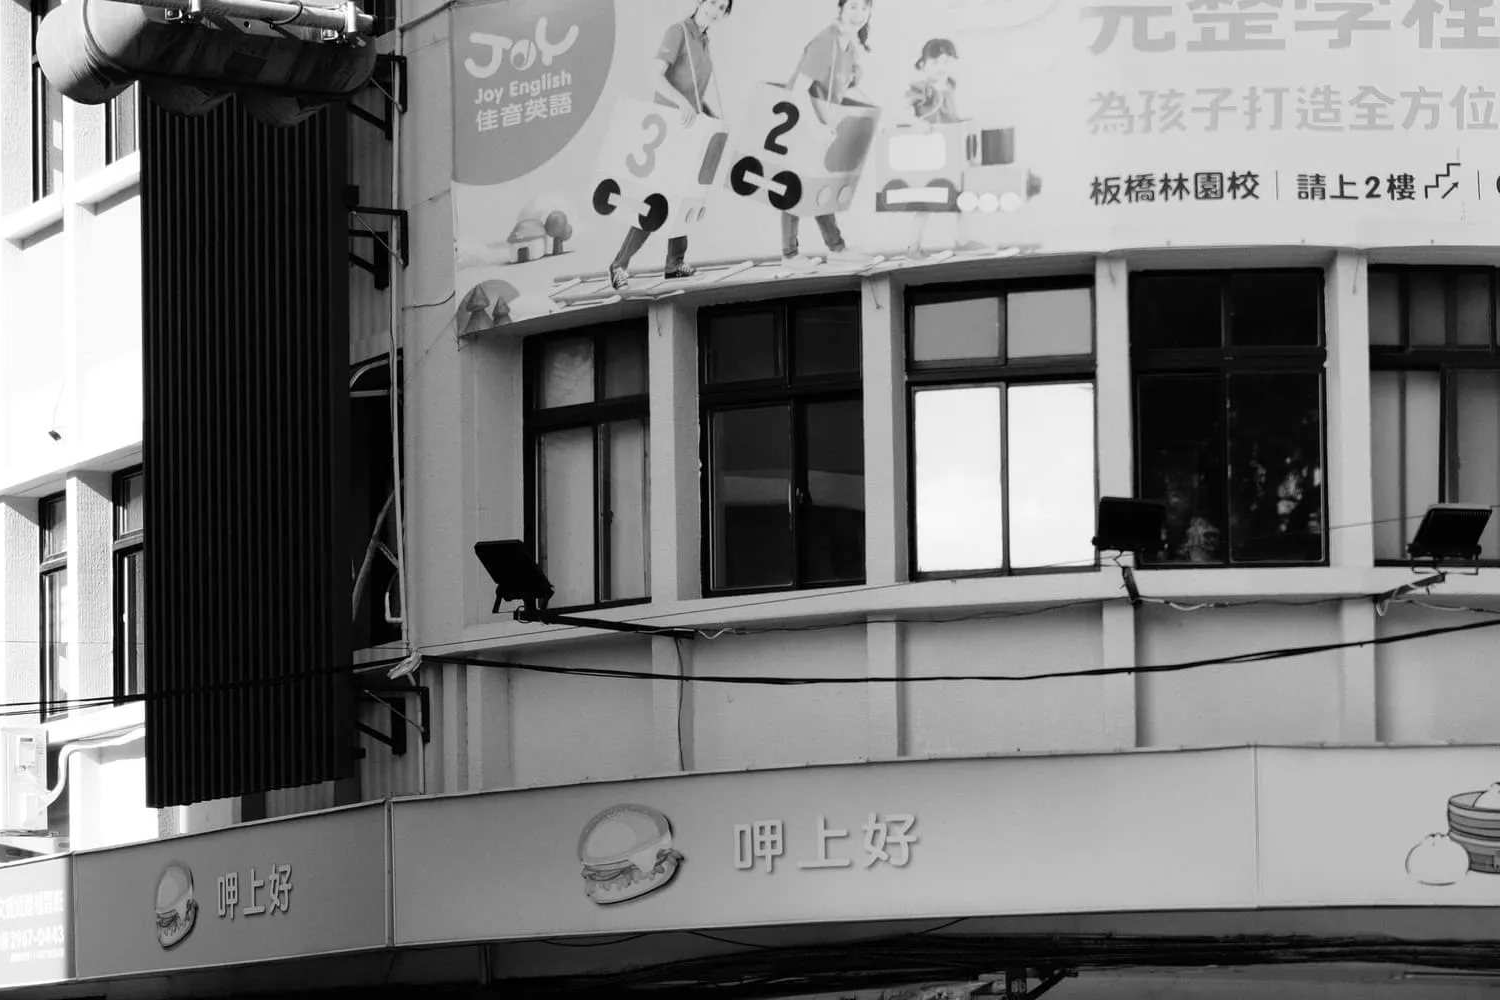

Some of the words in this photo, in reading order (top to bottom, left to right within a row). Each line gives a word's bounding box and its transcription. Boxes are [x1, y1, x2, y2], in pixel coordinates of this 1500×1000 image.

[474, 83, 504, 105] Joy
[509, 70, 572, 97] English
[476, 94, 573, 132] 佳音英語
[1088, 85, 1498, 135] 為孩子打造全方位
[626, 114, 667, 178] 3
[764, 101, 799, 155] 2
[1090, 170, 1260, 206] 板橋林園校
[1297, 173, 1416, 201] 請上2樓
[734, 812, 920, 873] 呷上好
[217, 863, 293, 918] 呷上好
